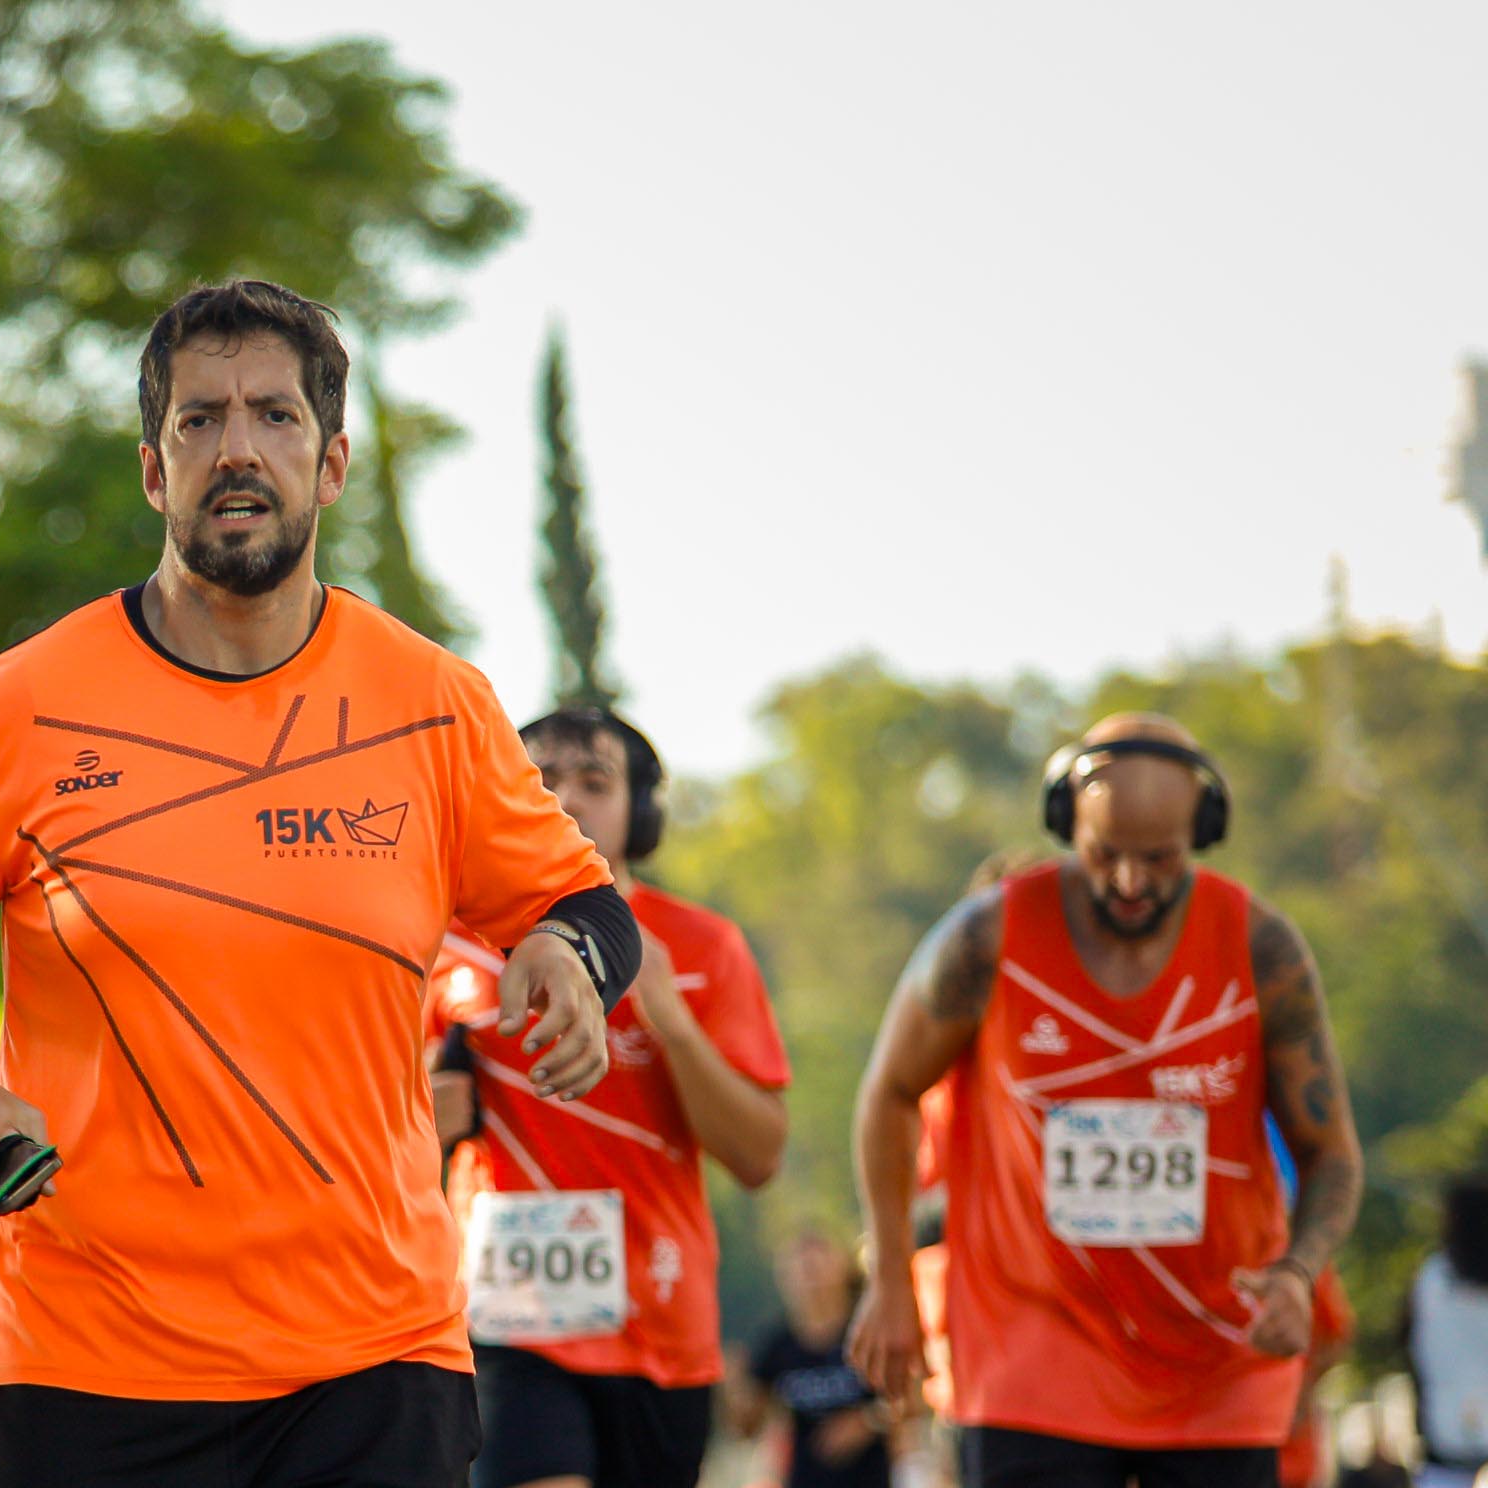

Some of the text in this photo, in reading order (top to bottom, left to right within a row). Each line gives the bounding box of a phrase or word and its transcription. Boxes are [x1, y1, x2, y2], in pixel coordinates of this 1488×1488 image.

[255, 808, 336, 845] 15K
[264, 849, 399, 860] PUERTO NORTE
[1055, 1143, 1197, 1190] 1298
[477, 1238, 613, 1286] 1906
